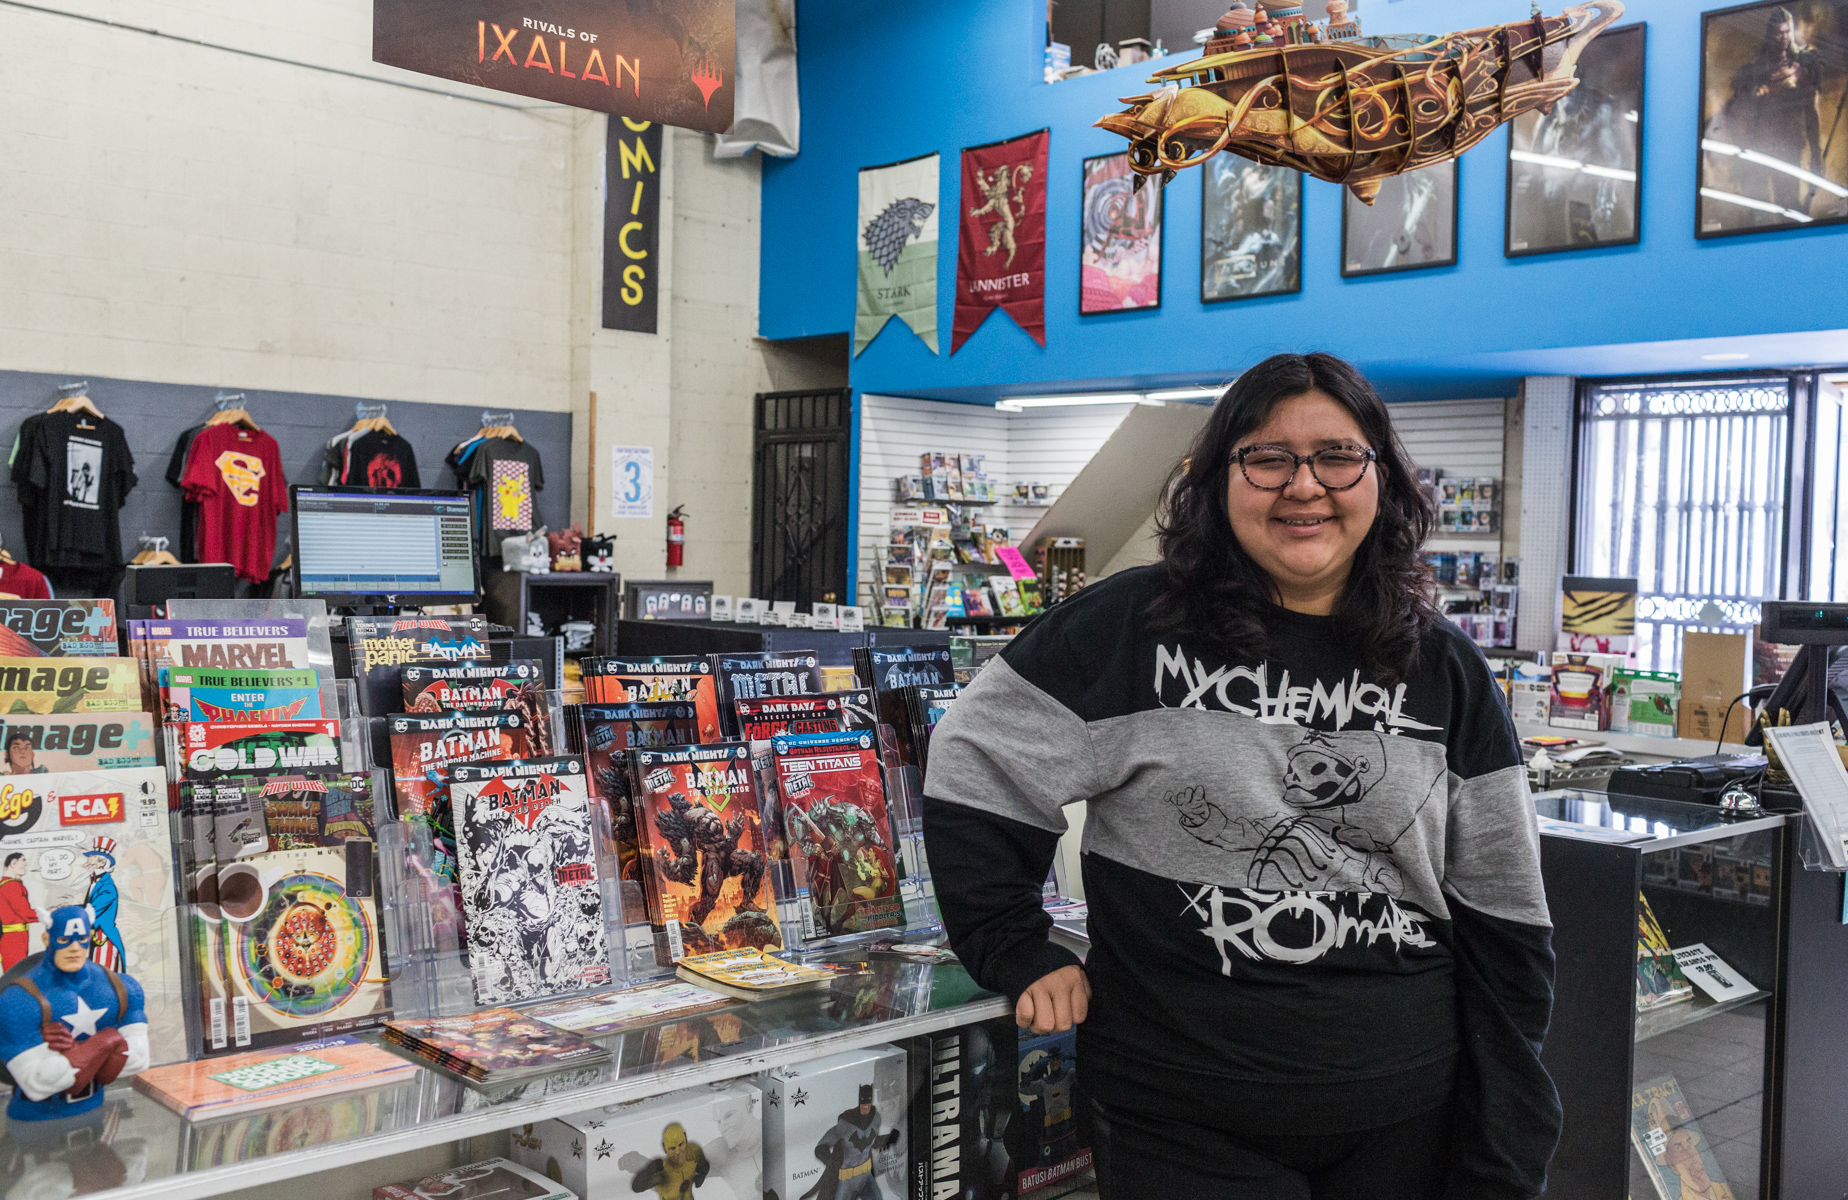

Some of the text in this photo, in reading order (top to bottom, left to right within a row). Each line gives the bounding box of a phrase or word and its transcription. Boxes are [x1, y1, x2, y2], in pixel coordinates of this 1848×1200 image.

[522, 17, 598, 43] RIVALS OF
[478, 20, 641, 98] IXALAN
[877, 285, 911, 300] STARK
[625, 461, 641, 503] 3
[446, 506, 469, 514] Diamond
[151, 627, 172, 636] MARVEL
[186, 625, 289, 637] TRUE BELIEVERS
[392, 619, 452, 632] MILK WARS
[181, 643, 295, 669] MARVEL
[421, 642, 486, 661] BATMAN
[887, 654, 907, 663] DARK
[908, 653, 936, 662] NIGHTS
[362, 650, 417, 671] panic
[607, 662, 692, 673] DC DARK NIGHTS
[723, 658, 798, 670] DC DARK NIGHTS
[175, 675, 193, 684] MARVEL
[407, 666, 509, 679] DC DARK NIGHTS
[889, 672, 940, 689] BATMAN
[199, 675, 310, 687] TRUE BELIEVERS #1
[628, 676, 691, 702] BATMAN
[731, 671, 813, 699] METAL
[1154, 643, 1445, 735] MY CHEMICAL
[231, 693, 265, 702] ENTER
[441, 687, 502, 701] BATMAN
[934, 690, 954, 698] DARK
[604, 709, 631, 720] DARK
[632, 708, 667, 719] NIGHTS
[740, 702, 816, 714] DC DARK DAYS
[395, 716, 499, 730] DC DARK NIGHTS
[754, 713, 806, 721] DIRECTOR'S
[795, 719, 839, 734] CASTING
[420, 727, 501, 762] BATMAN
[626, 728, 686, 748] BATMAN
[641, 749, 729, 763] DC DARK NIGHTS
[777, 744, 788, 752] DC
[789, 747, 814, 755] GOTHAM
[815, 745, 851, 754] RESISTANCE
[190, 745, 338, 772] COLD WAR
[421, 763, 435, 772] THE
[469, 748, 501, 762] MACHINE
[780, 757, 861, 773] TEEN TITANS
[455, 763, 559, 779] DC DARK NIGHTS
[685, 769, 748, 789] BATMAN
[259, 779, 328, 798] MILK WARS
[643, 771, 677, 793] METAL
[784, 775, 814, 796] METAL
[216, 793, 242, 801] ANIMAL
[488, 779, 561, 811] BATMAN
[705, 785, 750, 796] DEVASTATOR
[0, 784, 33, 820] Ego
[63, 797, 109, 818] FCA
[266, 801, 320, 818] SWAMP
[490, 798, 561, 820] THE RED DEATH
[268, 817, 319, 835] THING
[557, 866, 595, 885] METAL
[64, 917, 86, 936] A
[1645, 1080, 1676, 1099] TRACY
[792, 1168, 820, 1181] BATMAN
[1022, 1152, 1093, 1190] BATUSI BATMAN BUST
